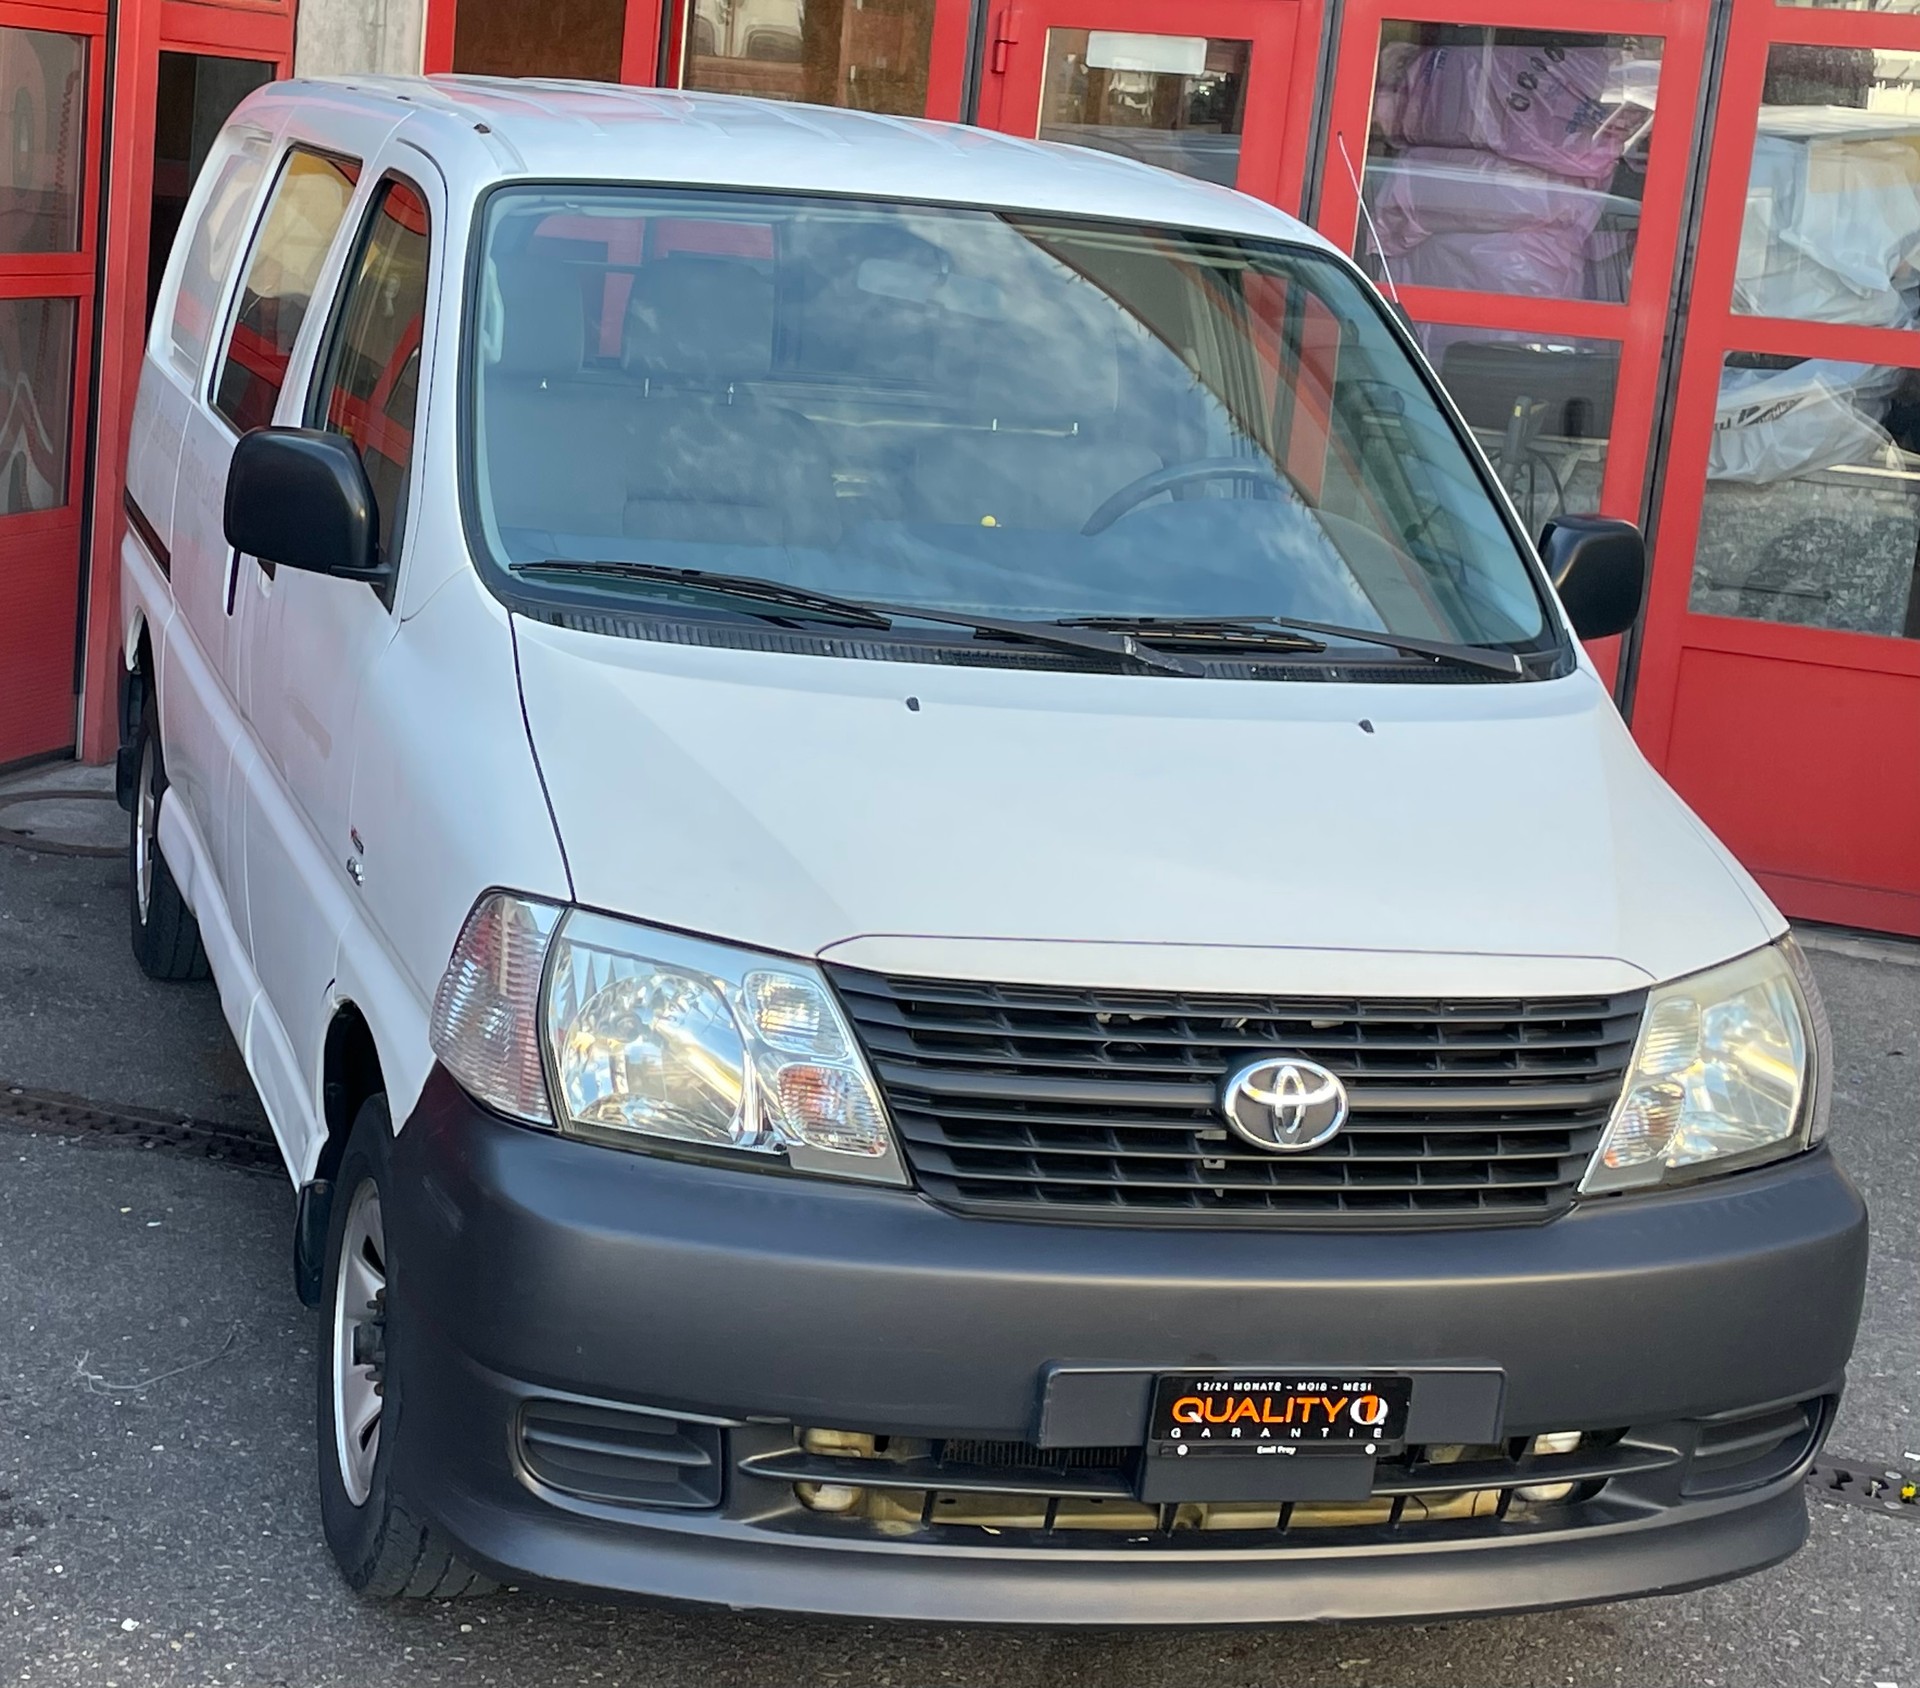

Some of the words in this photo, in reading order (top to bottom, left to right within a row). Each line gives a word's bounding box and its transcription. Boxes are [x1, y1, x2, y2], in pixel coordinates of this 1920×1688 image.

[1196, 1382, 1229, 1391] 12/24
[1233, 1382, 1281, 1392] MONATE
[1342, 1382, 1372, 1392] MESI
[1170, 1427, 1382, 1438] GARANTIE
